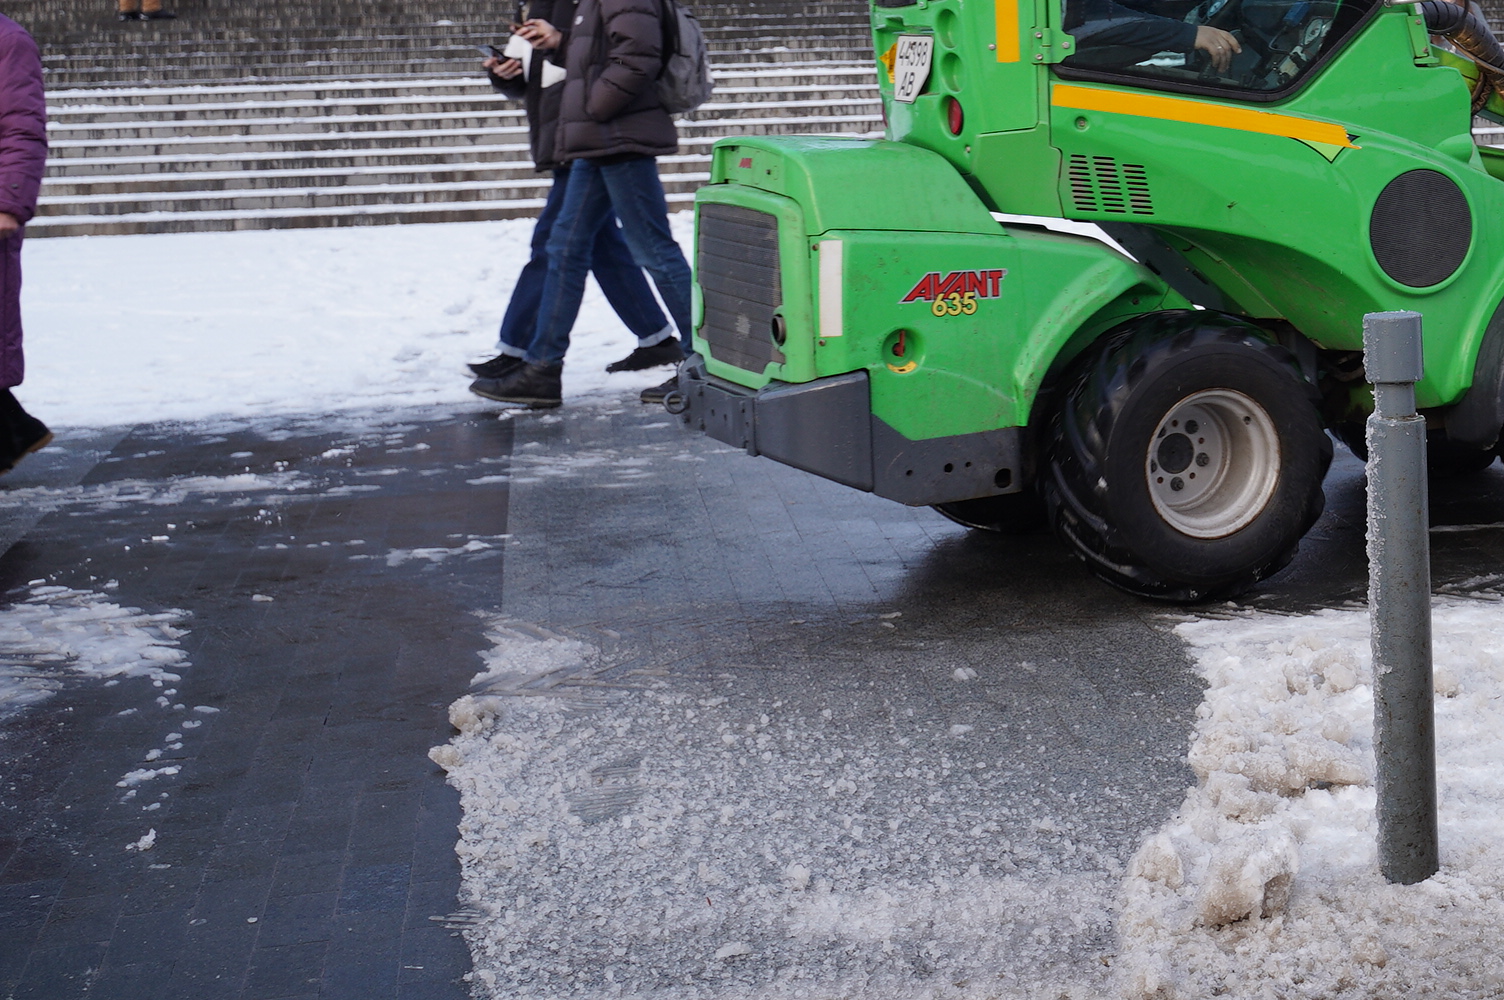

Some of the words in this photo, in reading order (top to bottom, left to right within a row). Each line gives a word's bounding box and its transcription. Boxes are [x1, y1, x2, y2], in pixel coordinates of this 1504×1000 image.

[898, 40, 929, 67] 44598
[897, 71, 915, 97] AB
[900, 269, 1004, 304] AVANT
[931, 292, 978, 317] 635
